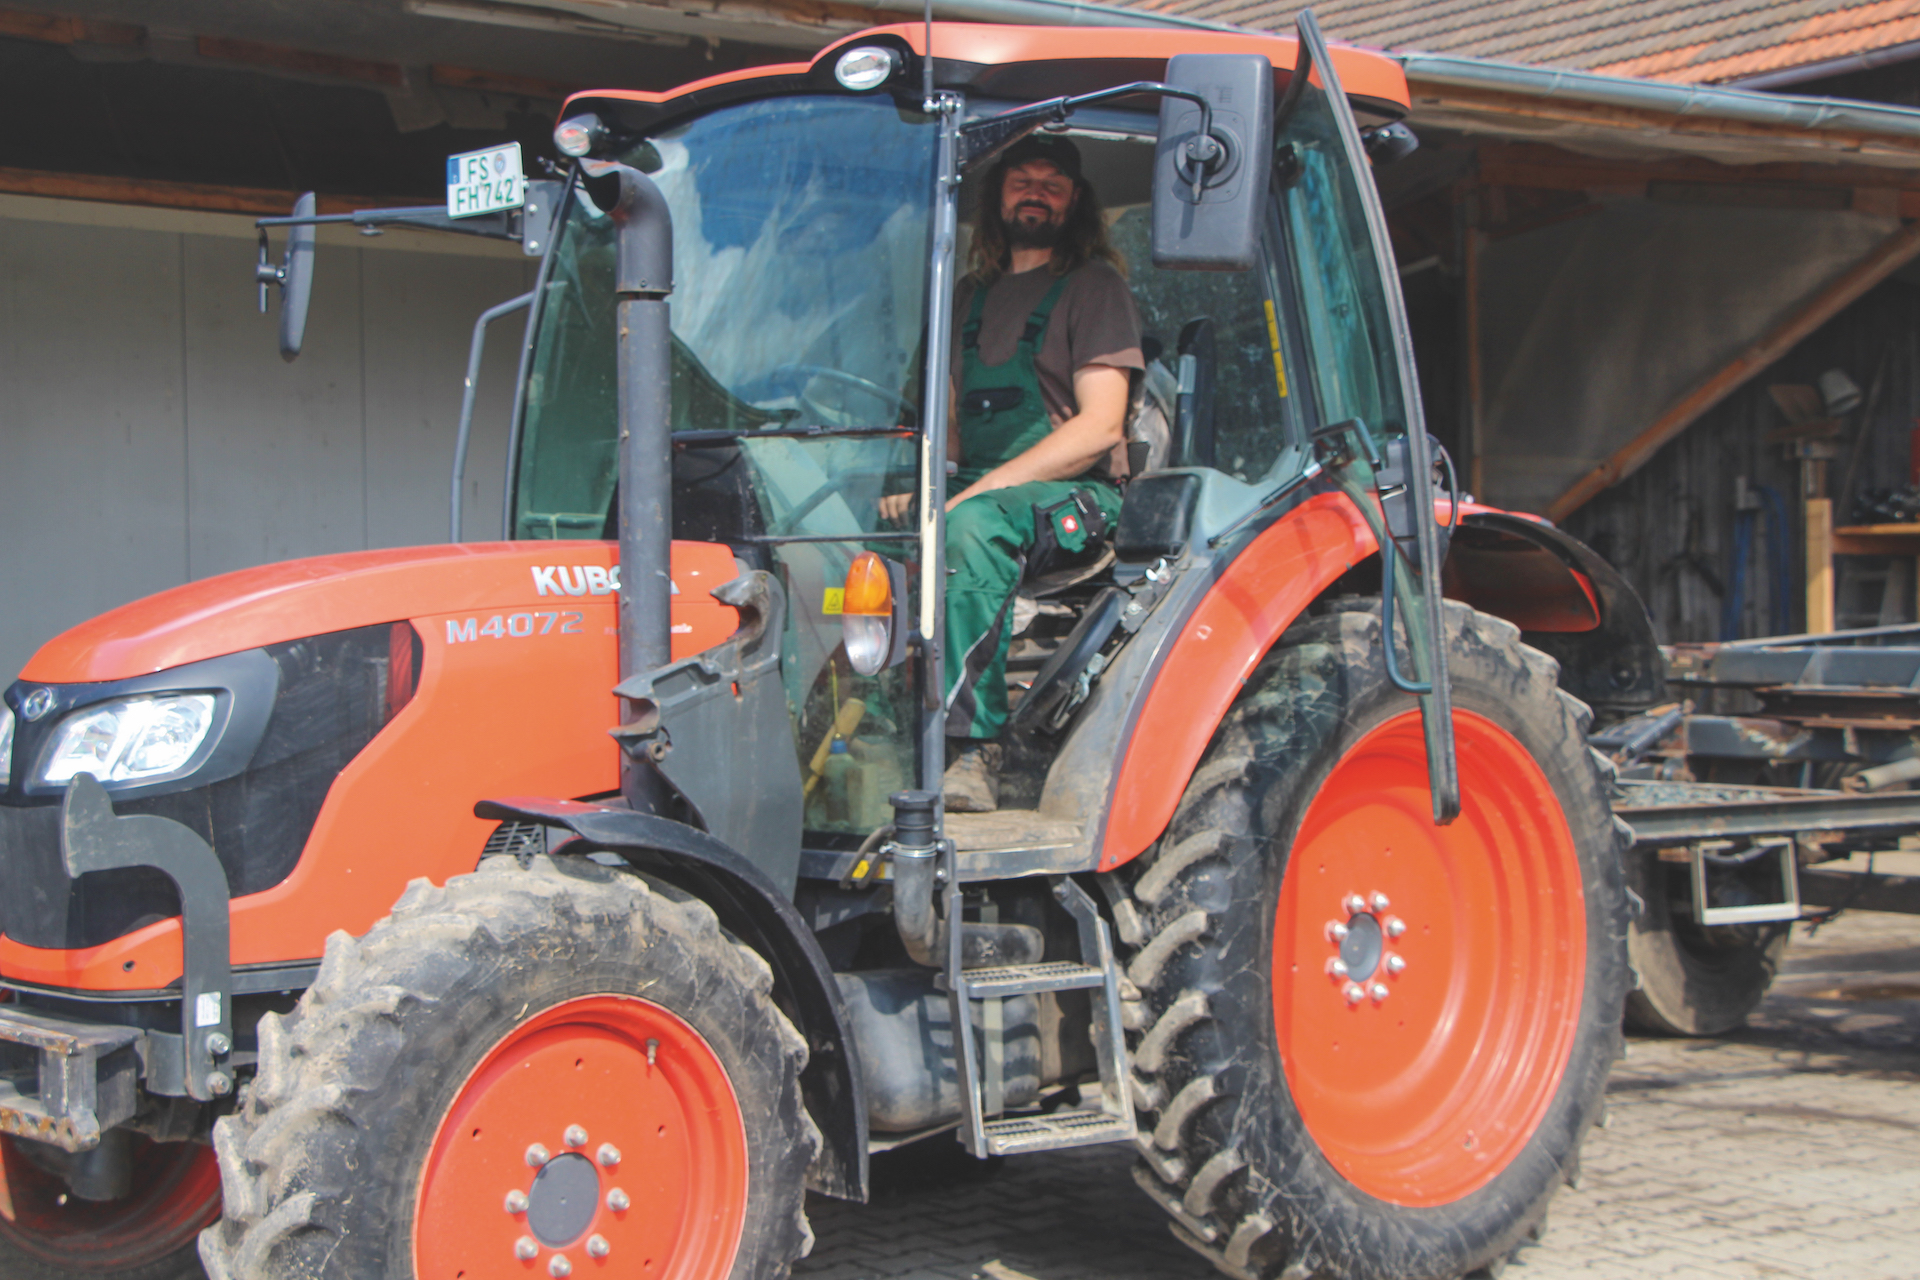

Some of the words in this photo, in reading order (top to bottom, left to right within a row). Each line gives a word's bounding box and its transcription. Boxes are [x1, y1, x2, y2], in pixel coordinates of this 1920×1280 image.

[468, 156, 489, 182] FS
[457, 185, 479, 212] FH
[484, 178, 514, 207] 742
[446, 611, 584, 644] M4072
